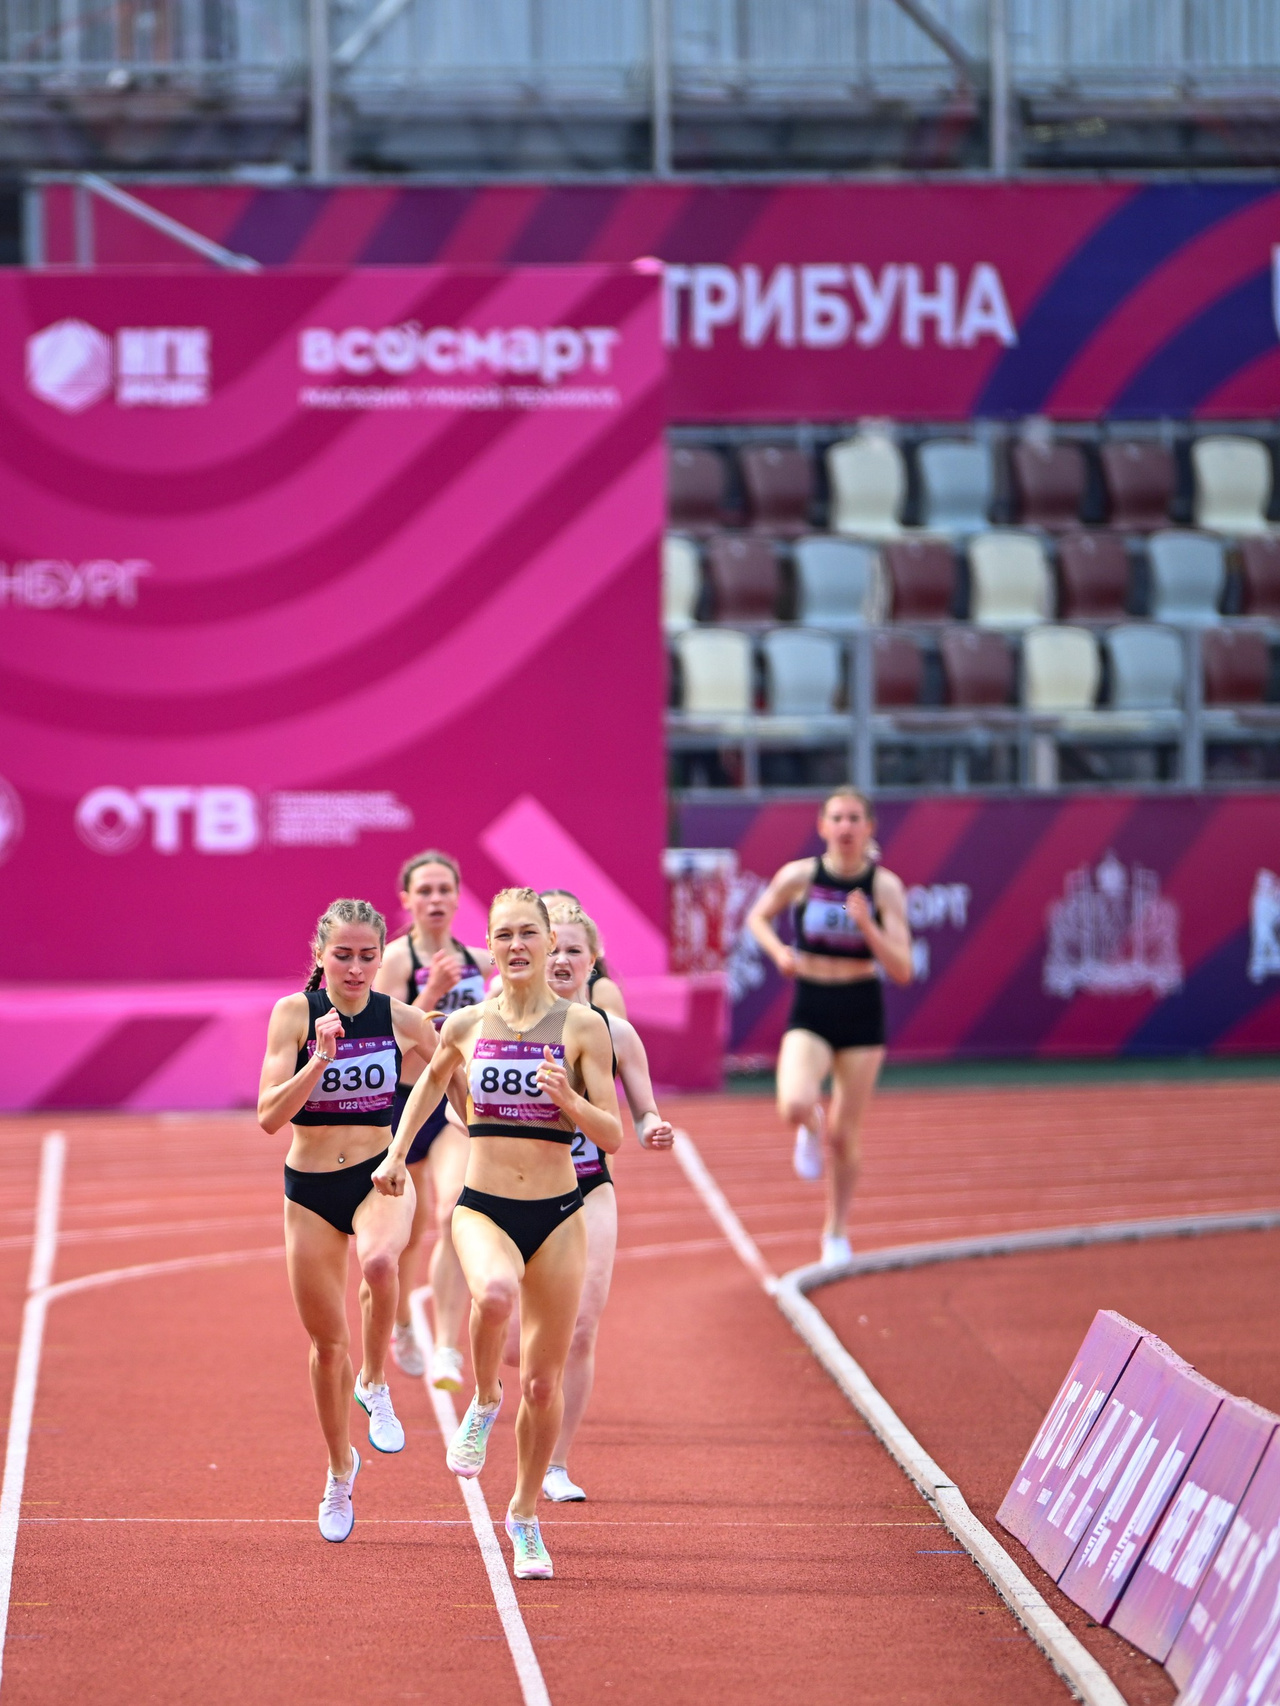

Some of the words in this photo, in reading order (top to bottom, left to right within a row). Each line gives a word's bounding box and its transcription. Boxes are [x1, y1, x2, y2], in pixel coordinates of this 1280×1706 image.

[322, 1063, 385, 1093] 830
[480, 1066, 544, 1098] 889
[338, 1101, 359, 1110] U23
[498, 1106, 519, 1117] U23
